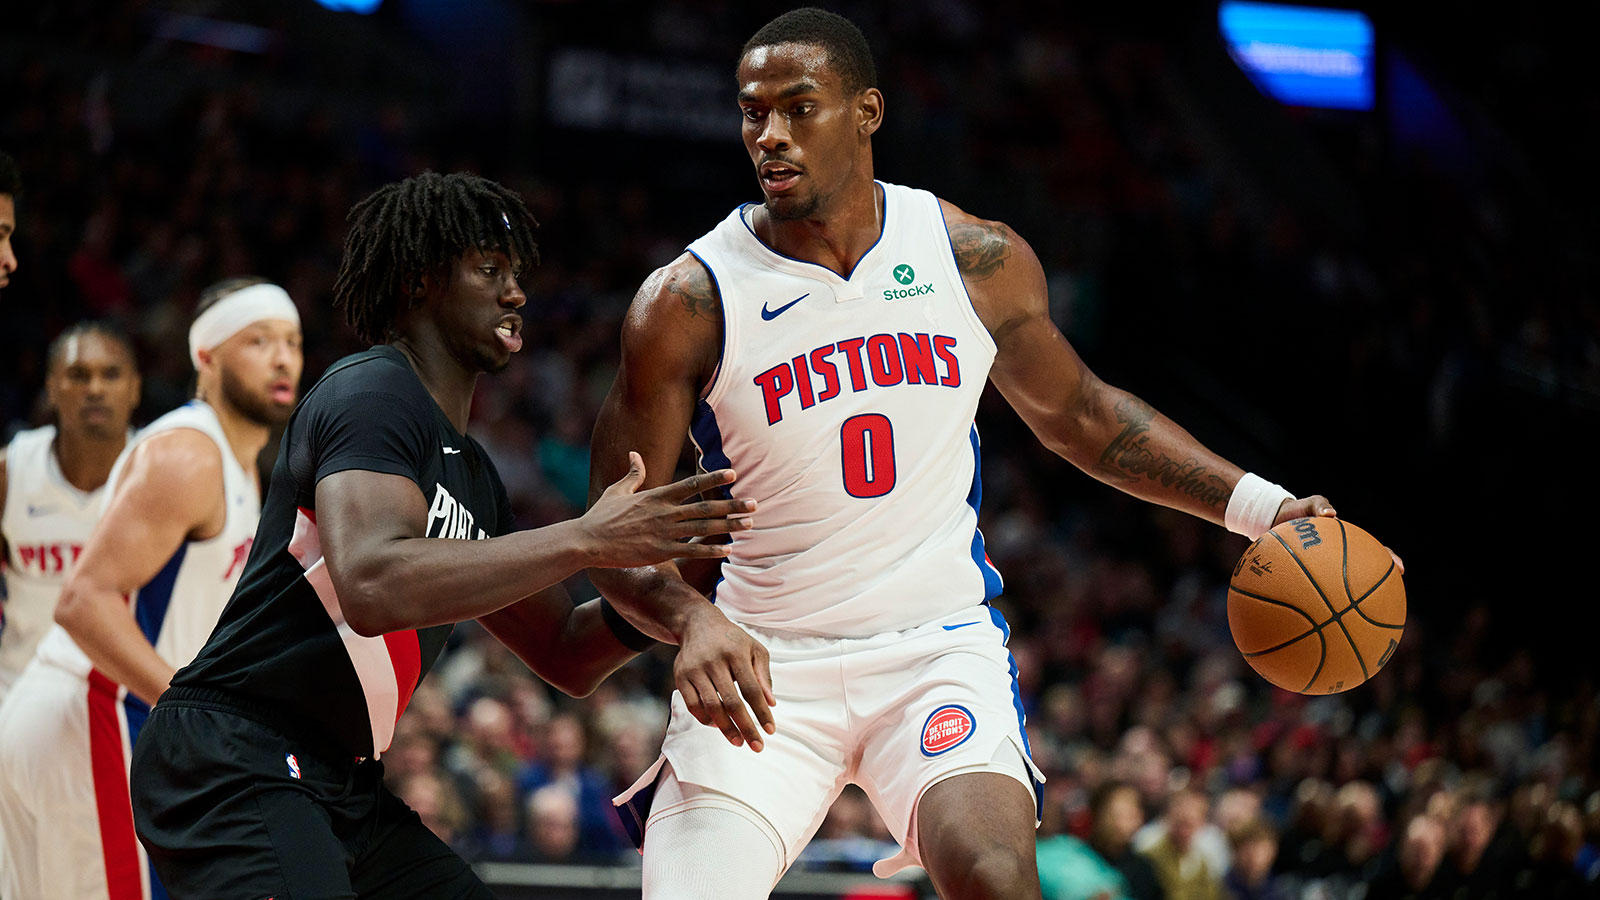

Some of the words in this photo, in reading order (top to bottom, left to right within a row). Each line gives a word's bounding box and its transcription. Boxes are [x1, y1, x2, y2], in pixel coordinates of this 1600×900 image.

[883, 283, 935, 301] StockX
[753, 332, 961, 425] PISTONS
[840, 413, 897, 499] 0
[425, 482, 490, 540] PORT
[18, 543, 84, 572] PIST
[928, 725, 964, 744] PISTONS
[929, 717, 963, 736] DETROIT
